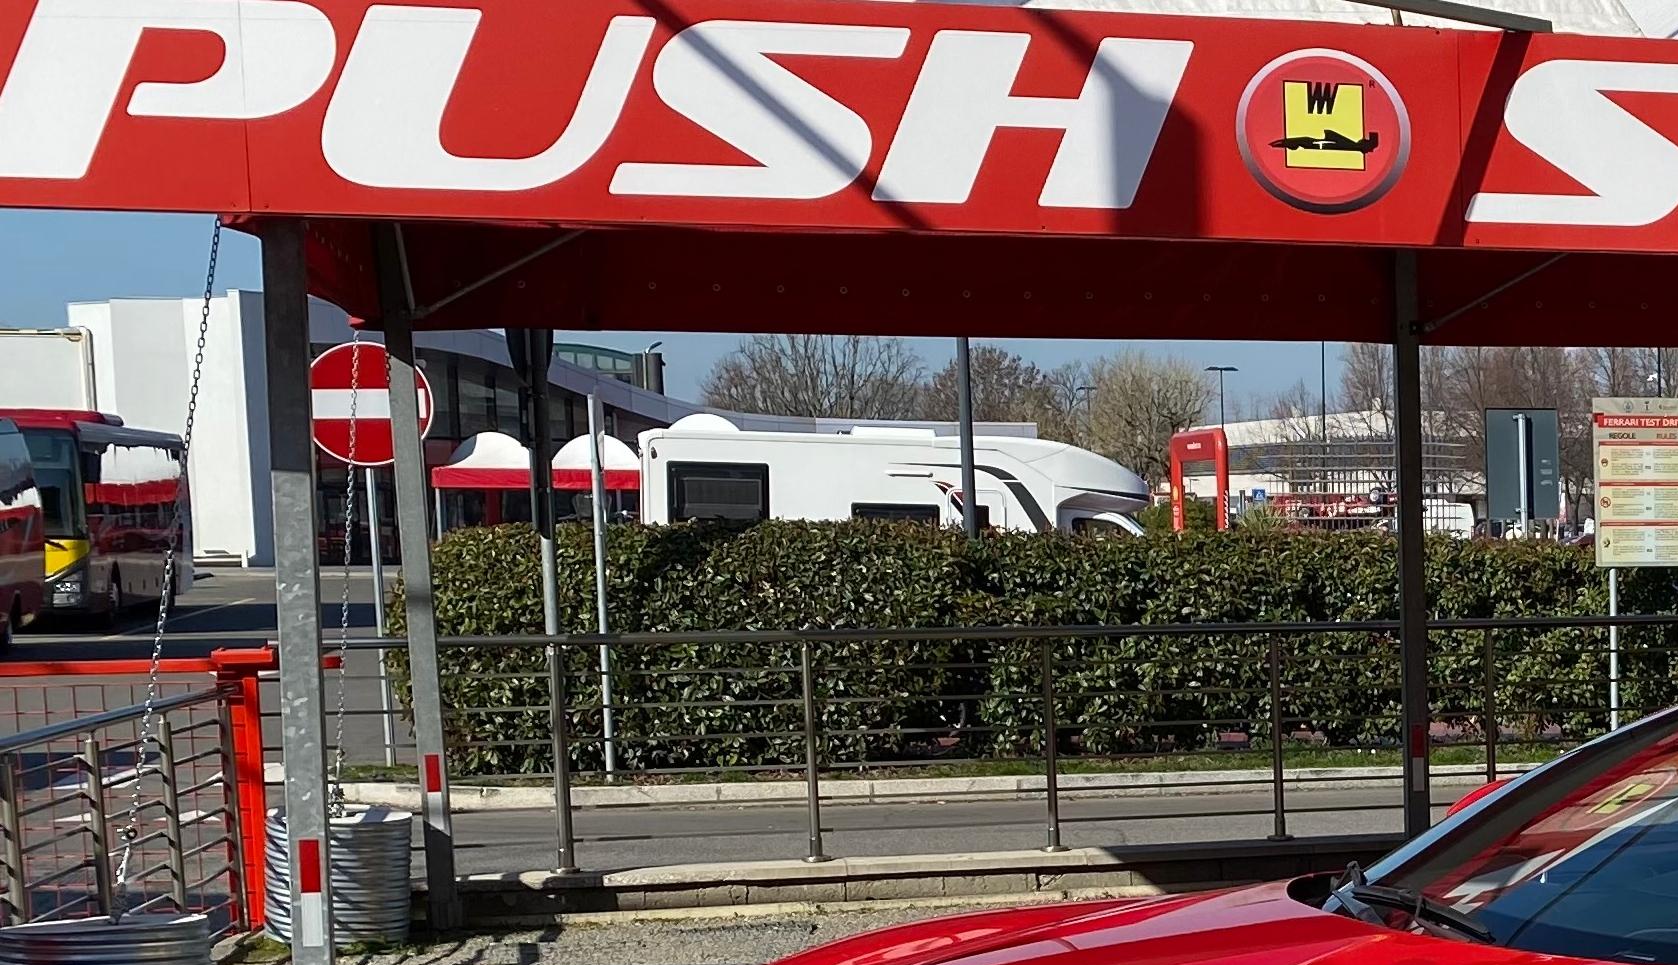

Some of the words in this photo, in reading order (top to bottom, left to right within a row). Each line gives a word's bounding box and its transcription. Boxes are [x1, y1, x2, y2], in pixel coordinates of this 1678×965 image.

[0, 0, 1194, 209] PUSH
[1603, 418, 1639, 427] FERRARI
[1640, 418, 1660, 427] TEST
